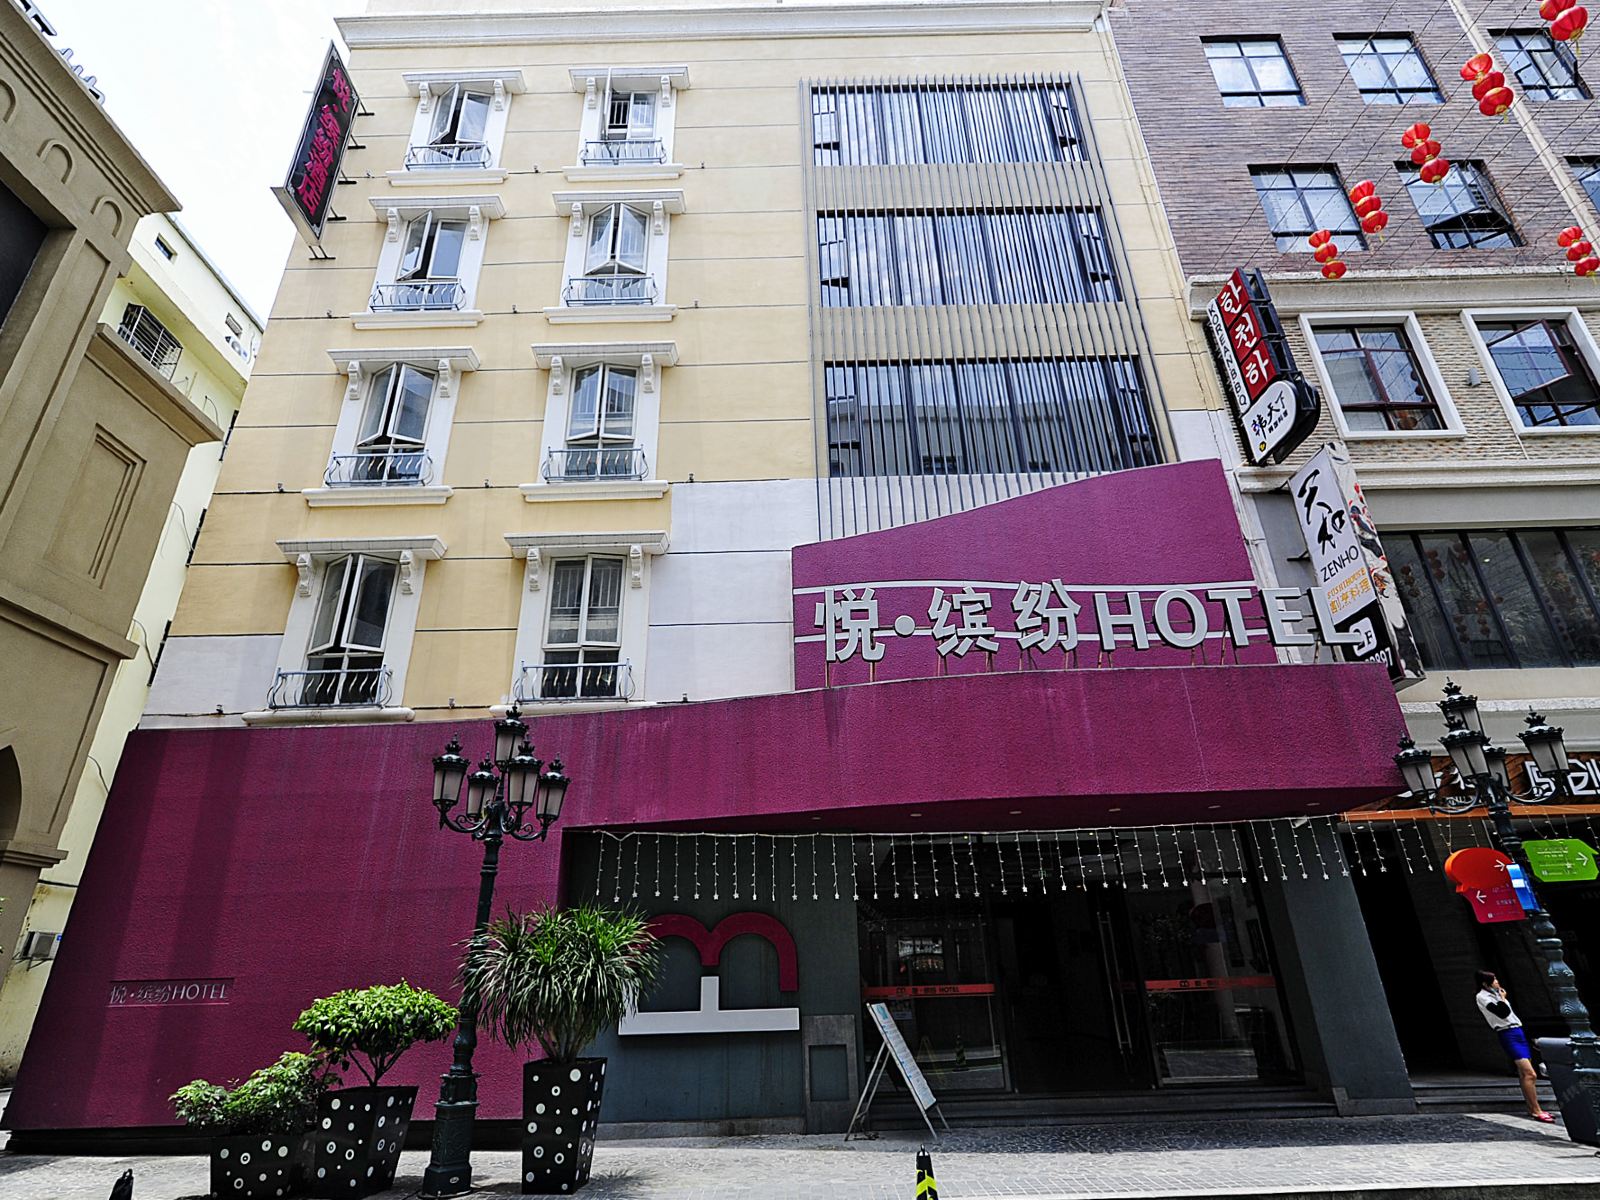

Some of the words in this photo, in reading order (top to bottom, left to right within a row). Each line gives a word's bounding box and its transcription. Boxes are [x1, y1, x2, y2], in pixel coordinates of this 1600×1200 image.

[1220, 279, 1269, 386] 한천하
[1321, 544, 1359, 582] ZENHO
[172, 983, 228, 1001] HOTEL
